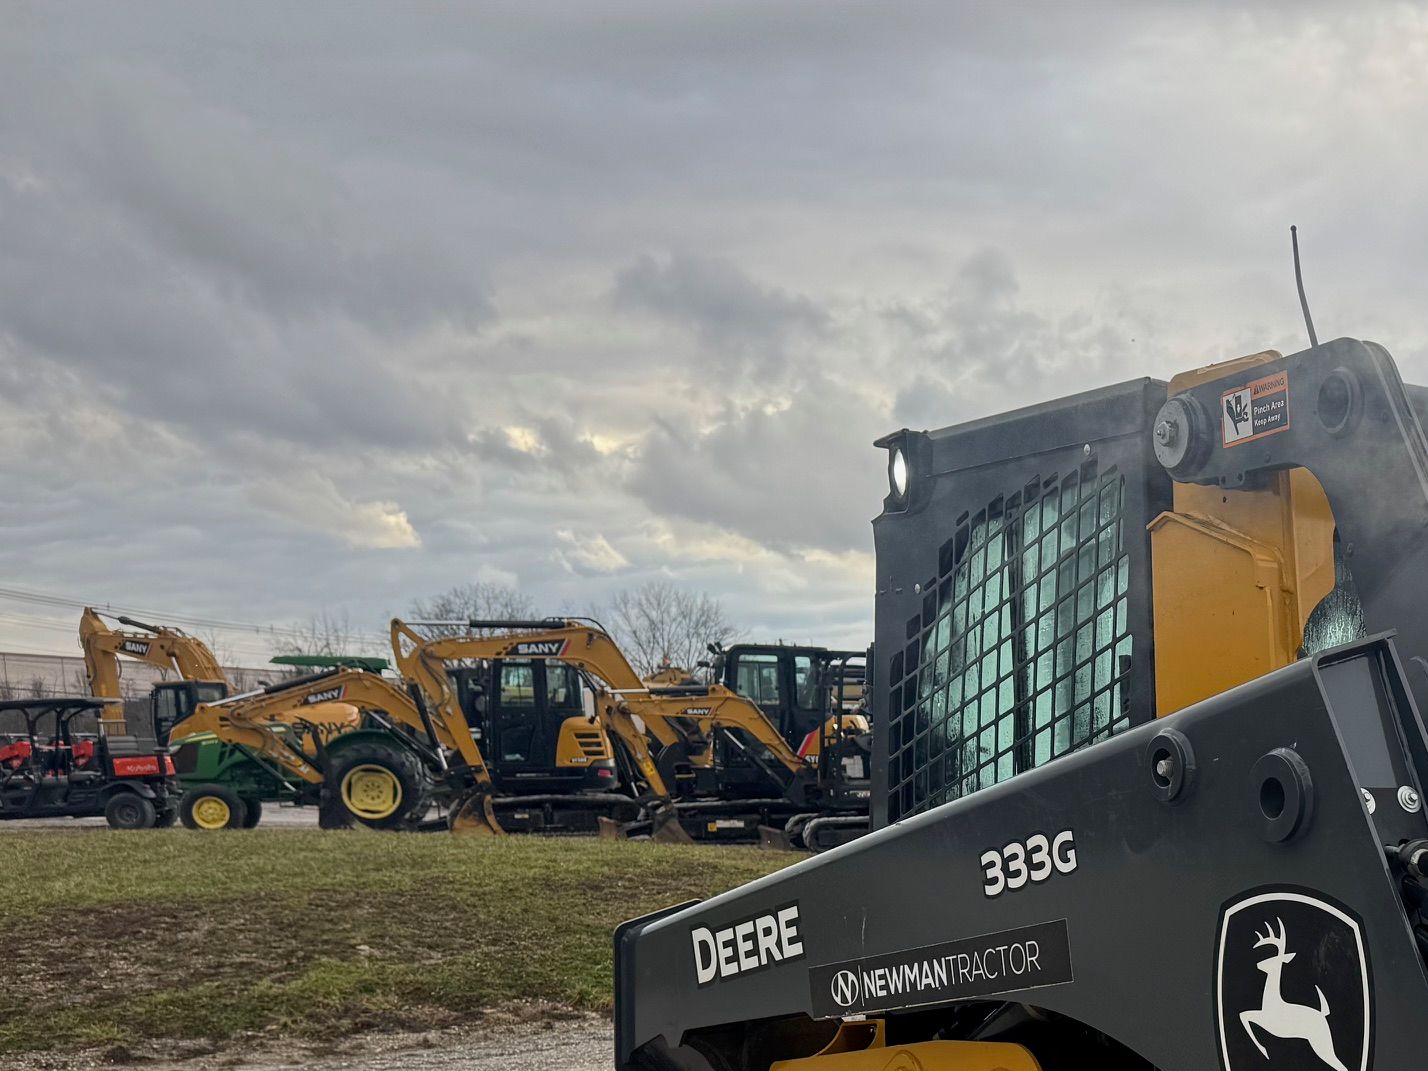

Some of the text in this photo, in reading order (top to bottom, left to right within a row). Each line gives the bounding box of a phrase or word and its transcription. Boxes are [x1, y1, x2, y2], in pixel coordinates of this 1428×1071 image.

[1253, 400, 1285, 415] Pinch Area
[1254, 413, 1281, 427] Keep Away
[125, 641, 148, 653] SANY
[518, 642, 560, 654] SANY
[307, 690, 340, 703] SANY
[980, 830, 1077, 895] 333G
[691, 905, 804, 984] DEERE
